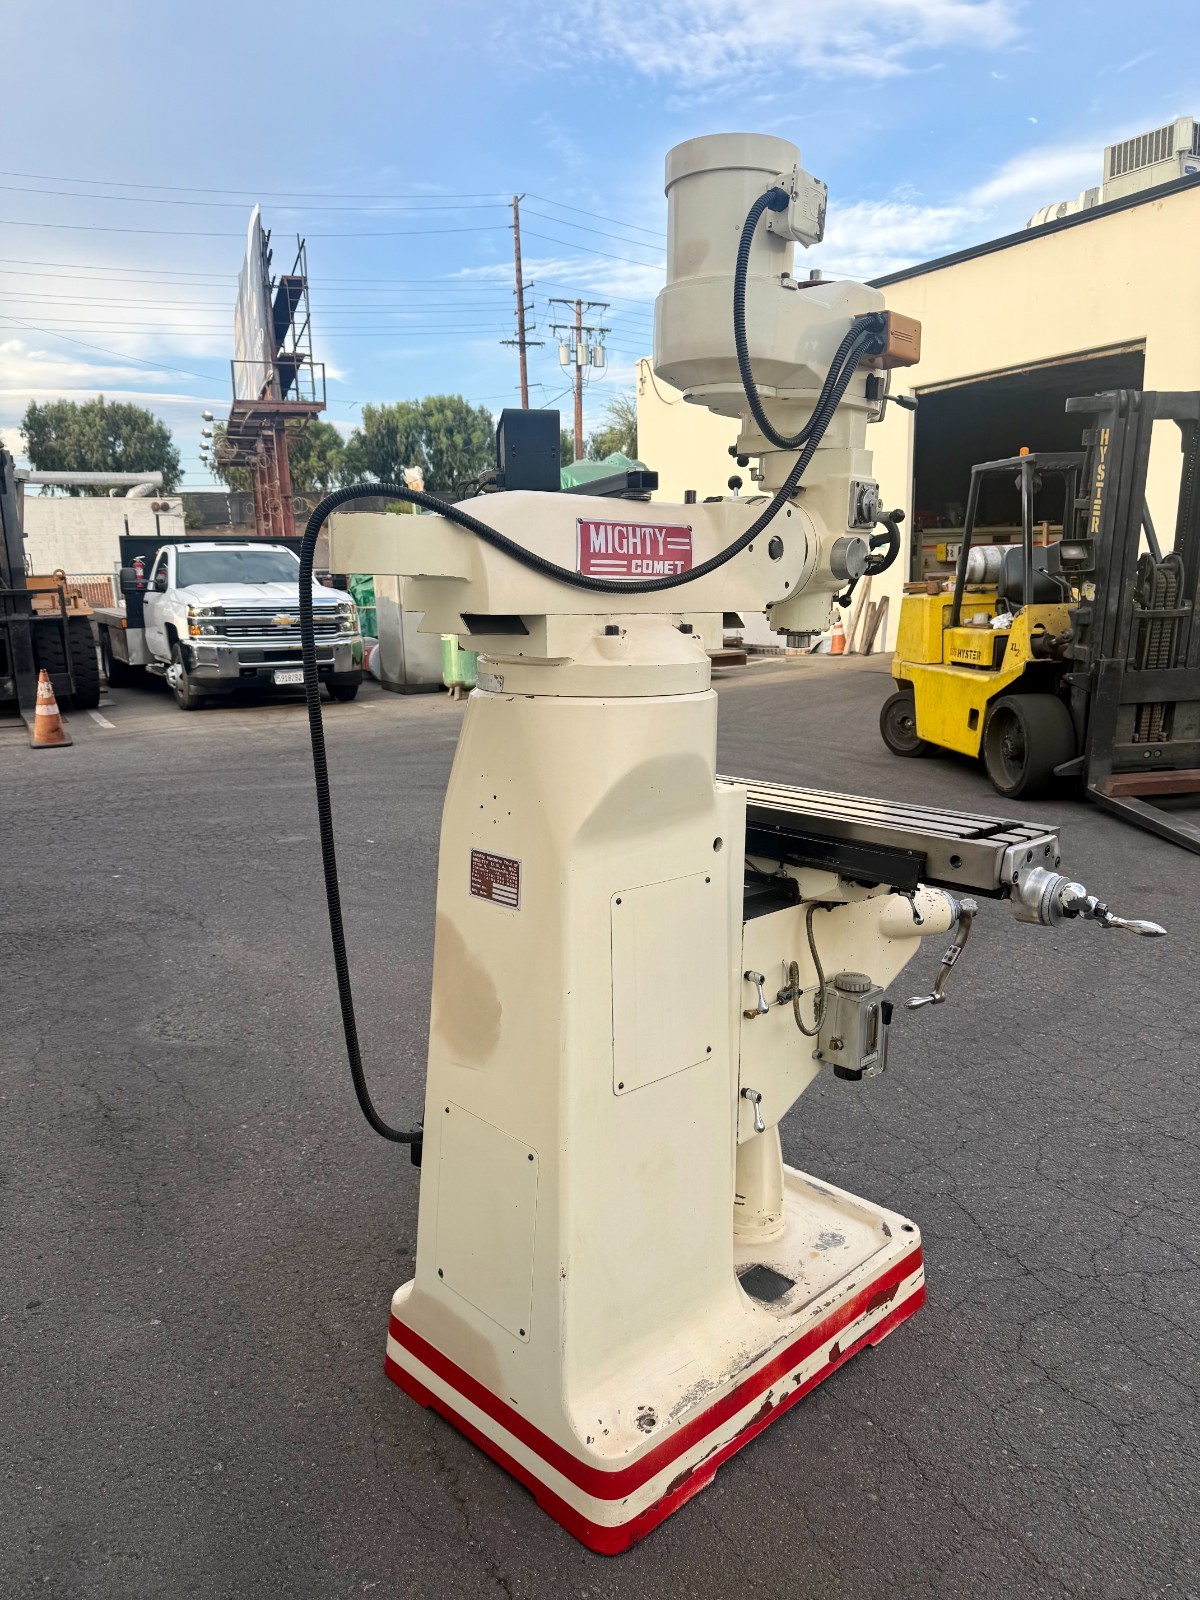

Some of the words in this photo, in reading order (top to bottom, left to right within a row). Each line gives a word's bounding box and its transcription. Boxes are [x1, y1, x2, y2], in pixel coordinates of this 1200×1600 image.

[1090, 428, 1110, 533] HYSTER
[589, 524, 667, 556] MIGHTY
[631, 559, 685, 575] COMET
[957, 648, 982, 661] HYSTER
